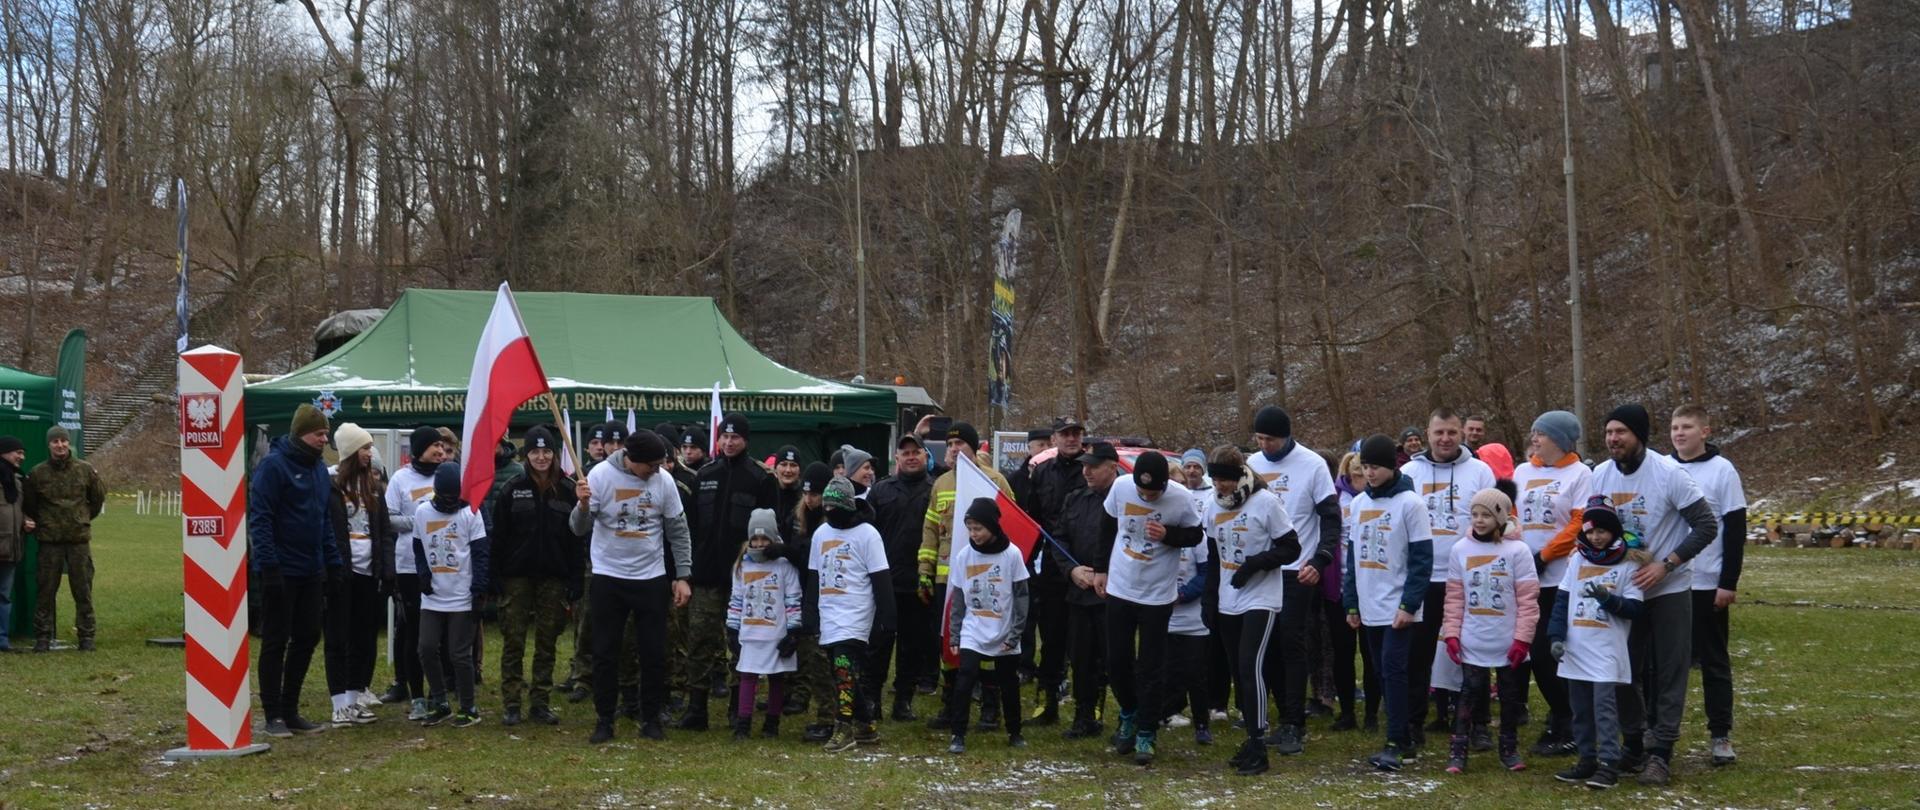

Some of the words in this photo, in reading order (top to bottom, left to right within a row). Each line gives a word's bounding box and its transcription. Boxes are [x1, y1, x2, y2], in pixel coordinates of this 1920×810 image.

[0, 389, 24, 411] EJ
[362, 397, 372, 412] 4
[575, 393, 648, 411] BRYGADA
[722, 395, 834, 412] TERYTORIALNEJ
[187, 431, 219, 444] POLSKA
[192, 519, 217, 534] 2389
